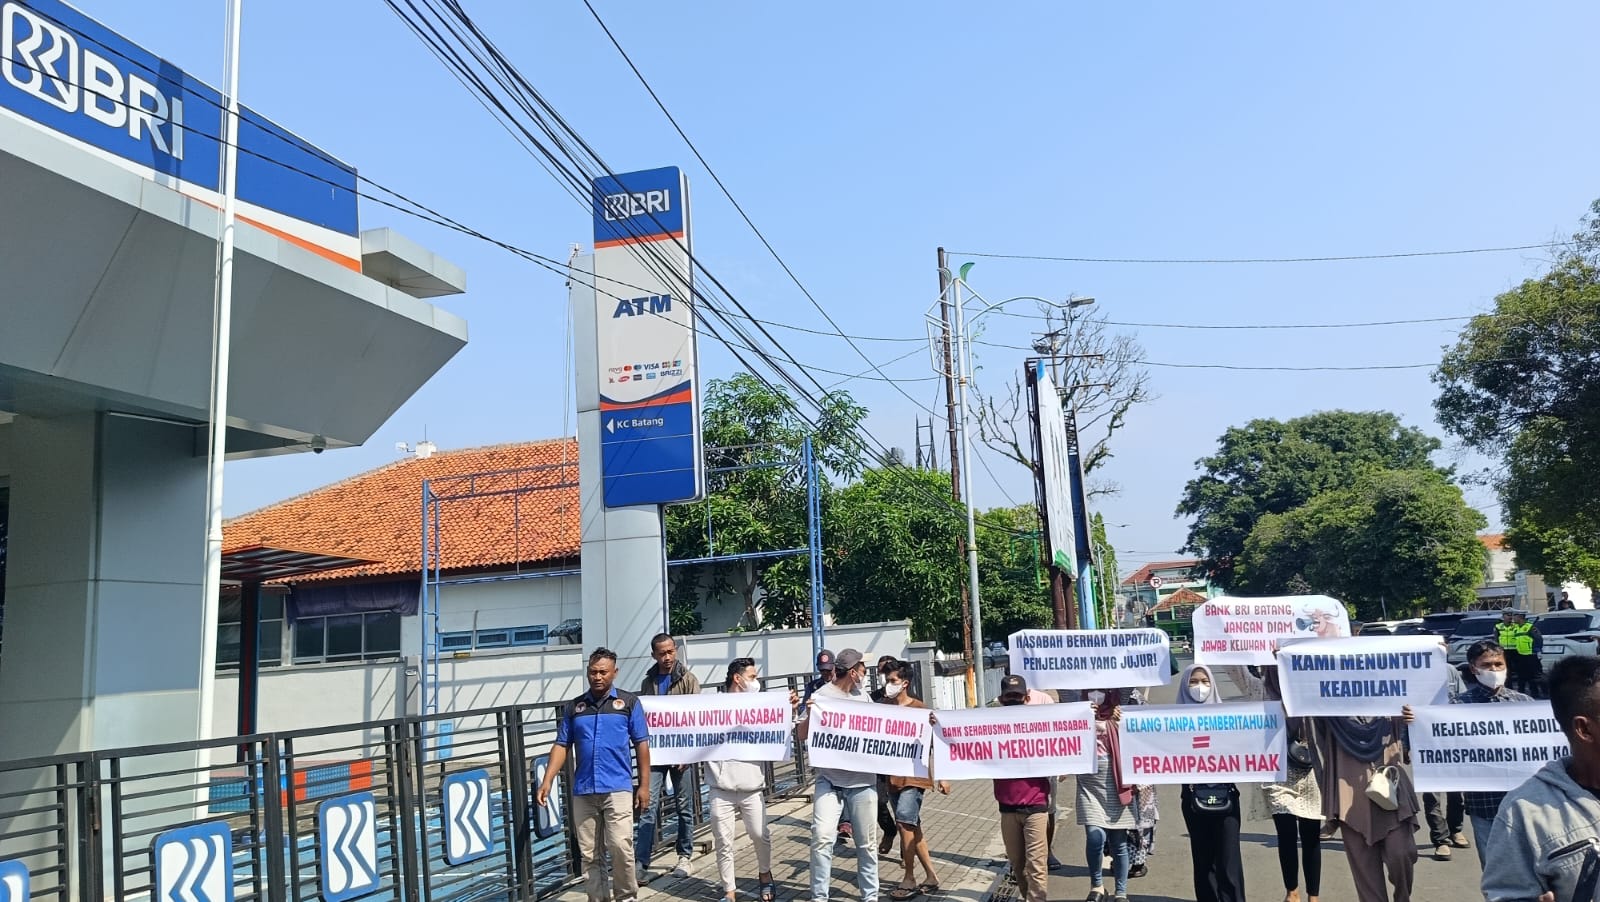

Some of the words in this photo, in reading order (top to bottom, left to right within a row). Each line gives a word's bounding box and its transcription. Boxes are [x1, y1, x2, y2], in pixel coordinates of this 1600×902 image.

[84, 49, 183, 160] BRI
[630, 189, 670, 216] BRI
[613, 294, 672, 318] ATM
[644, 363, 660, 371] VISA
[660, 369, 682, 377] BRIZZI
[617, 420, 629, 429] KC
[632, 417, 664, 428] Batang
[1205, 605, 1230, 616] BANK
[1235, 605, 1250, 616] BRI
[1254, 605, 1295, 616] BATANG,
[1224, 622, 1263, 633] JANGAN
[1267, 621, 1296, 635] DIAM,
[1016, 634, 1063, 649] NASABAH
[1067, 634, 1108, 648] BERHAK
[1112, 632, 1162, 647] DAPATKAN
[1201, 640, 1227, 652] JAWAB
[1230, 640, 1266, 652] KELUHAN
[1023, 656, 1087, 671] PENJELASAN
[1090, 656, 1117, 670] YANG
[1120, 653, 1157, 669] JUJUR!
[1291, 654, 1336, 671] KAMI
[1340, 652, 1432, 671] MENUNTUT
[1319, 679, 1407, 698] KEADILAN!
[645, 711, 696, 728] KEADILAN
[699, 709, 733, 727] UNTUK
[735, 708, 784, 726] NASABAH
[821, 710, 846, 729] STOP
[848, 714, 883, 733] KREDIT
[885, 718, 917, 738] GANDA
[1125, 716, 1162, 733] LELANG
[1164, 716, 1196, 732] TANPA
[1198, 714, 1278, 731] PEMBERITAHUAN
[1432, 720, 1510, 737] KEJELASAN,
[1513, 718, 1561, 734] KEADIL
[942, 725, 962, 737] BANK
[964, 723, 1012, 737] SEHARUSNYA
[1013, 720, 1051, 734] MELAYANI
[659, 733, 694, 749] BATANG
[696, 732, 725, 747] HARUS
[726, 730, 786, 745] TRANSPARAN!
[811, 731, 860, 753] NASABAH
[862, 737, 919, 759] TERDZALIMI
[950, 740, 993, 761] BUKAN
[998, 735, 1082, 759] MERUGIKAN!
[1132, 755, 1240, 774] PERAMPASAN
[1245, 754, 1280, 772] HAK
[1418, 747, 1518, 764] TRANSPARANSI
[1522, 746, 1549, 762] HAK
